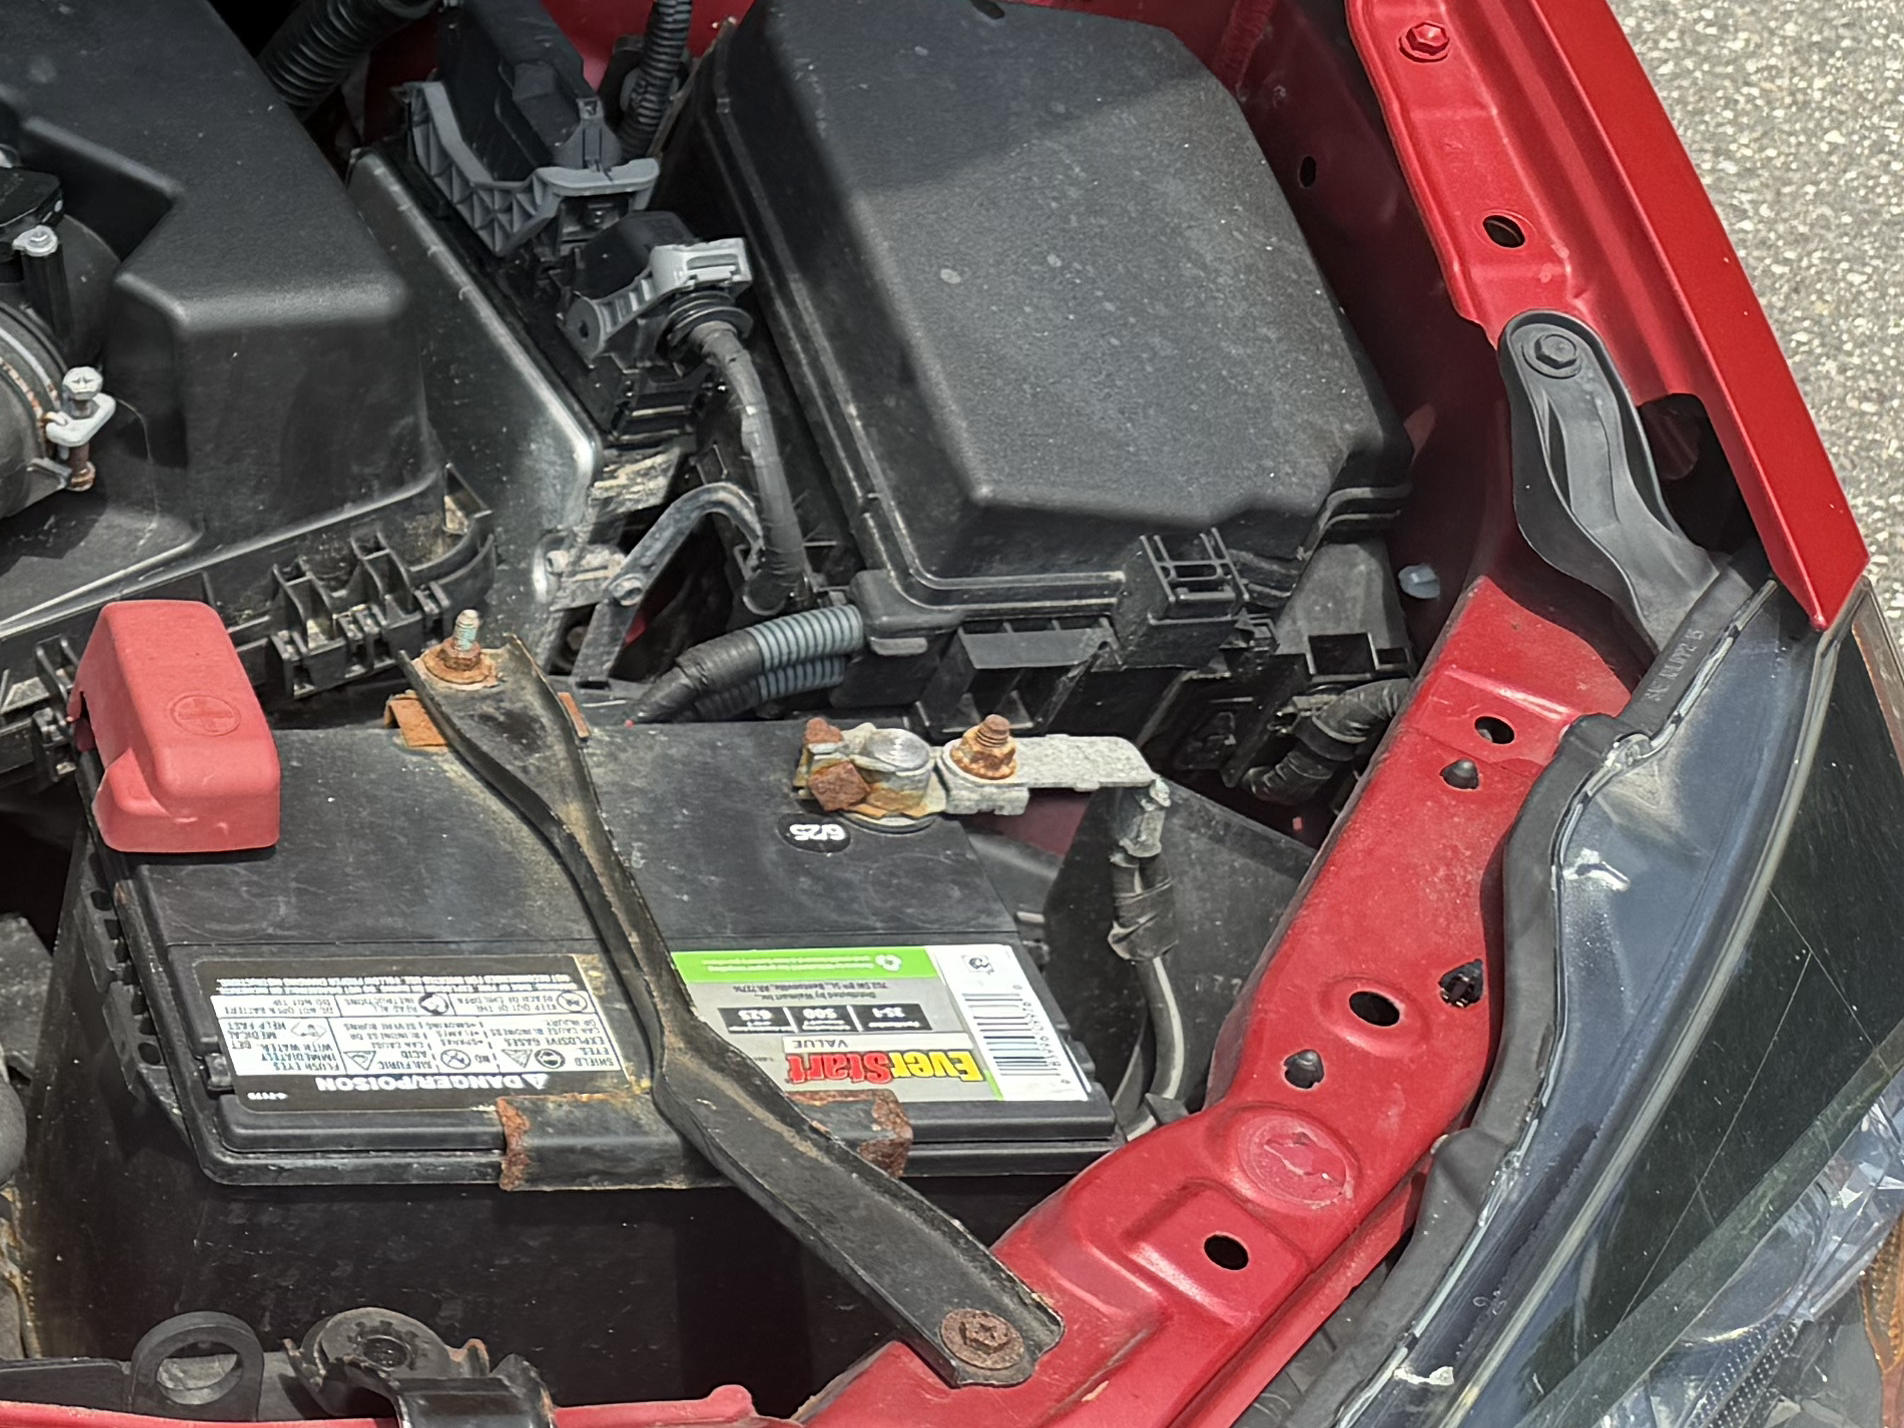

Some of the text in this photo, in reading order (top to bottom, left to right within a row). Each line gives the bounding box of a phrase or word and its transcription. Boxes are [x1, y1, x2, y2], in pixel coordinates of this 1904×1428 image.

[791, 1039, 848, 1048] VALUE
[400, 1051, 427, 1059] ACID
[574, 1057, 614, 1066] SHIELD
[786, 1050, 985, 1085] EverStart
[315, 1074, 525, 1091] DANGER/POISON
